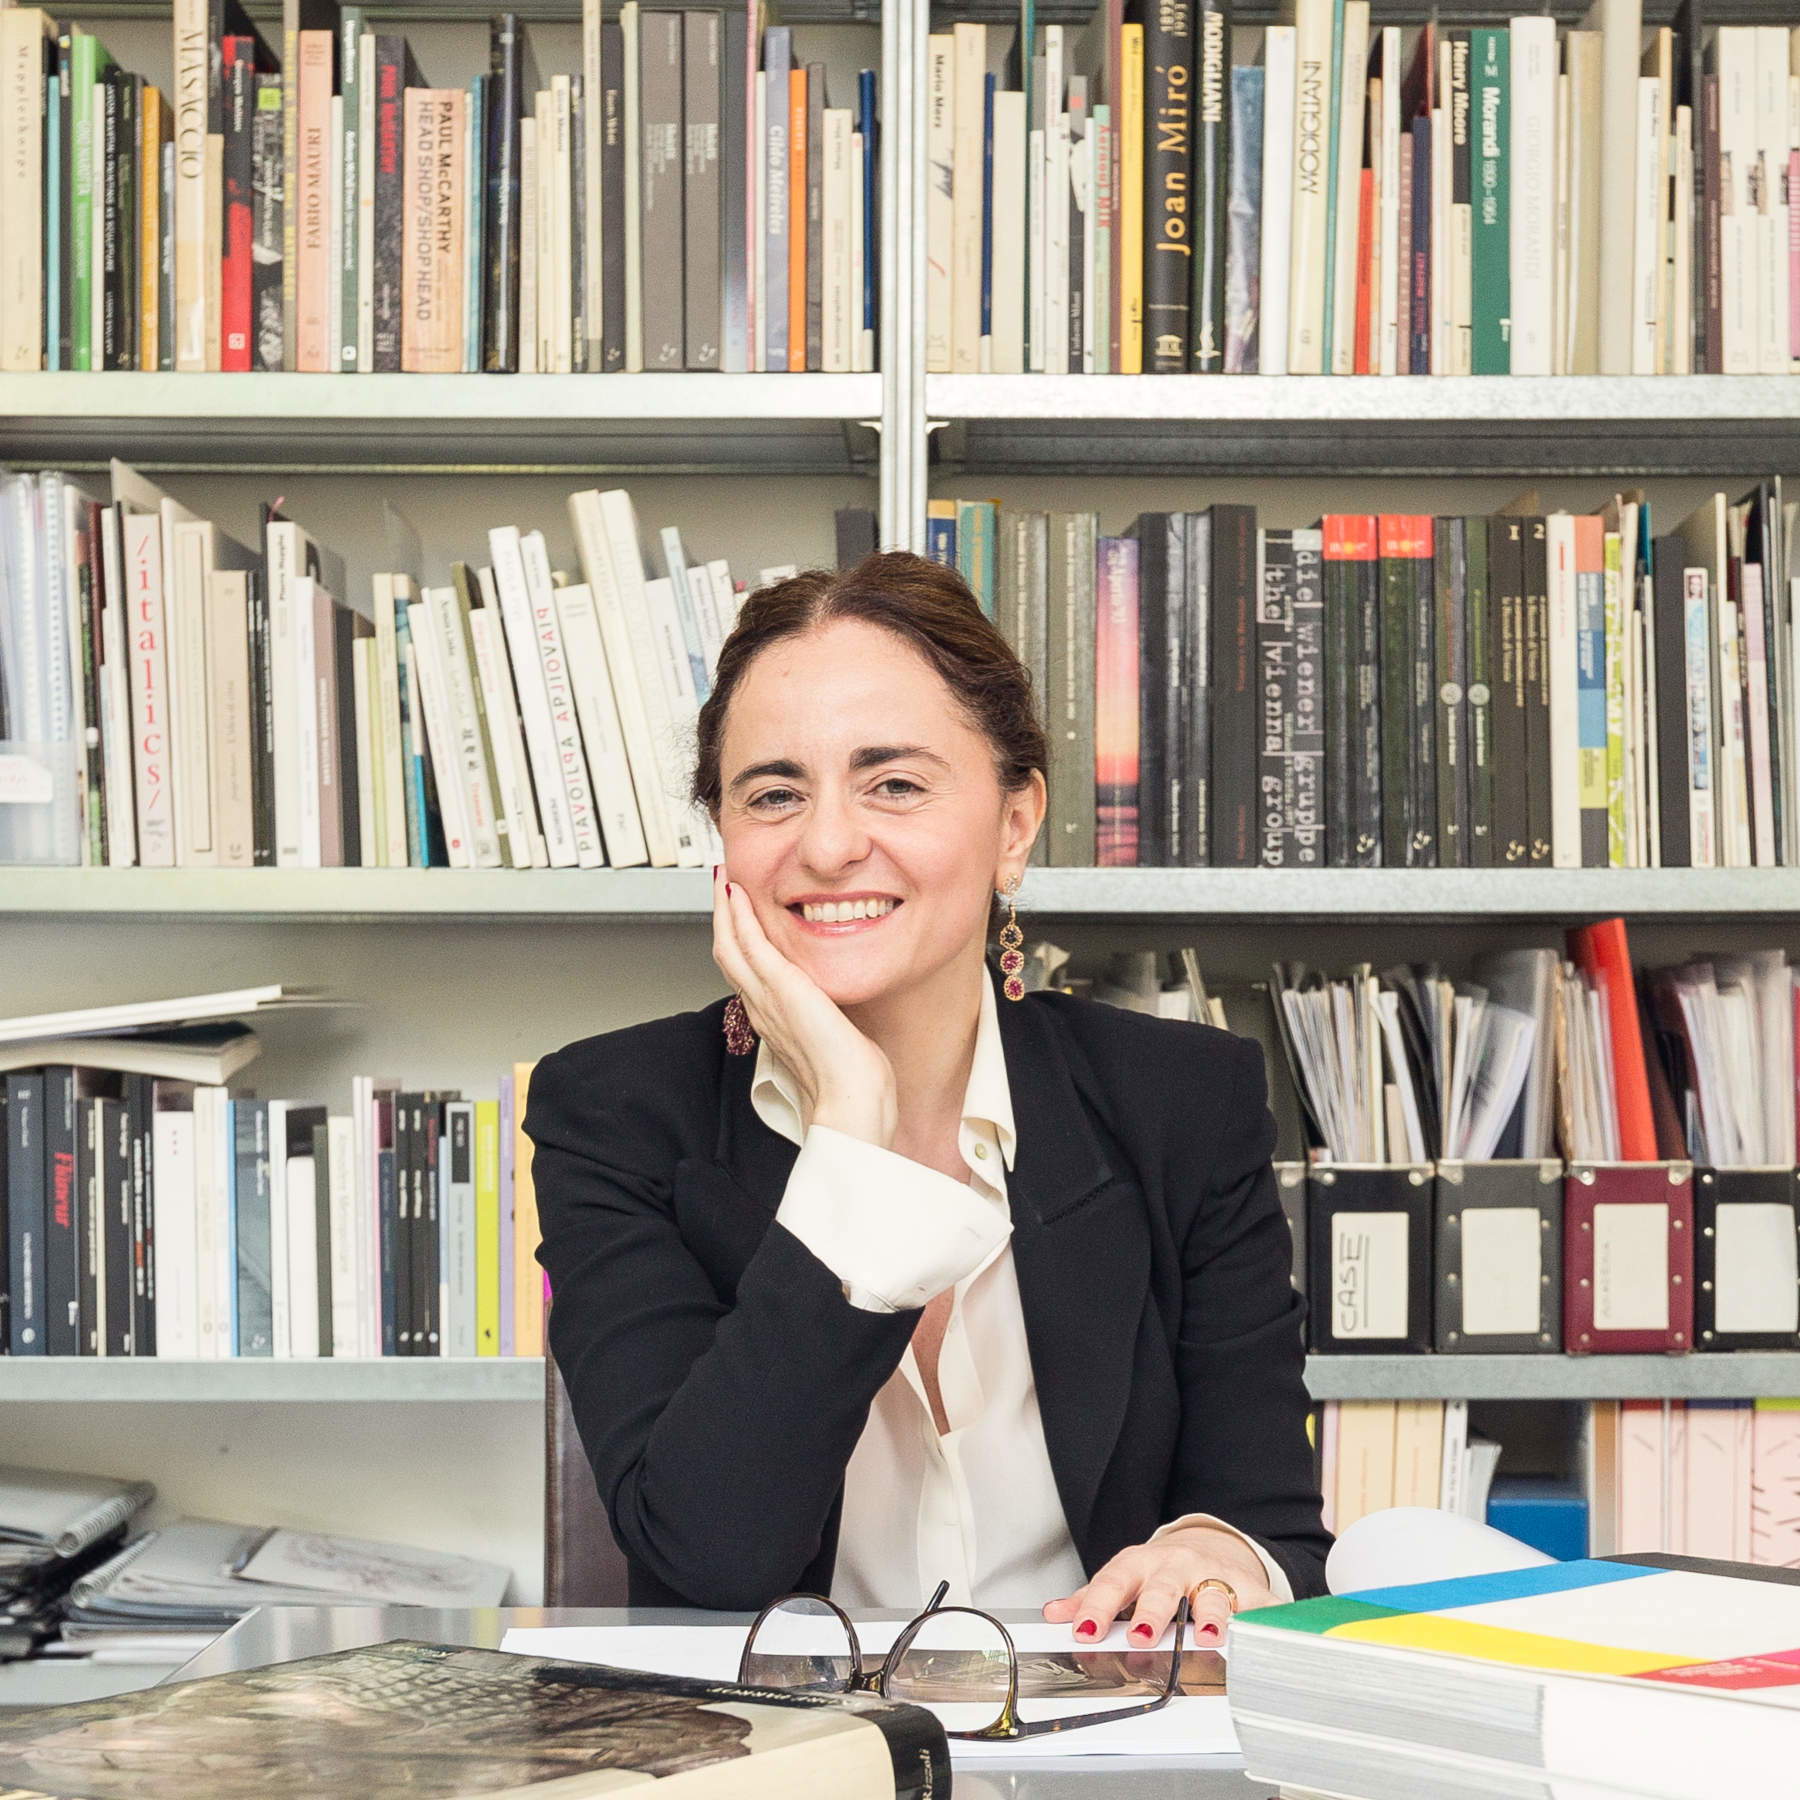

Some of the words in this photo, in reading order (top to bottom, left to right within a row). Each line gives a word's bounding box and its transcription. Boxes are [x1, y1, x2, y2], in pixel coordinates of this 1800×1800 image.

[934, 54, 944, 93] Mario
[1202, 11, 1222, 123] MODIGLIANI
[1453, 41, 1469, 88] Henry
[16, 45, 29, 179] Mapplethorpe
[179, 29, 203, 179] MASACCIO
[417, 101, 432, 157] HEAD
[438, 102, 452, 144] PAUL
[934, 97, 944, 128] Merz
[1155, 65, 1189, 154] Miró
[1300, 60, 1322, 195] MODIGLIANI
[1454, 92, 1469, 145] Moore
[1483, 87, 1499, 157] Morandi
[307, 128, 320, 188] MAURI
[769, 125, 784, 167] Cildo
[307, 193, 321, 249] FABIO
[437, 153, 451, 253] McCARTHY
[768, 169, 784, 235] Meireles
[1155, 172, 1190, 256] Joan
[417, 270, 431, 321] HEAD
[1264, 568, 1287, 620] the
[1296, 550, 1317, 602] die
[1264, 646, 1287, 751] vienna
[1296, 623, 1318, 731] wiener
[1262, 775, 1286, 865] group
[1293, 755, 1319, 862] gruppe
[1339, 1232, 1365, 1332] CASE
